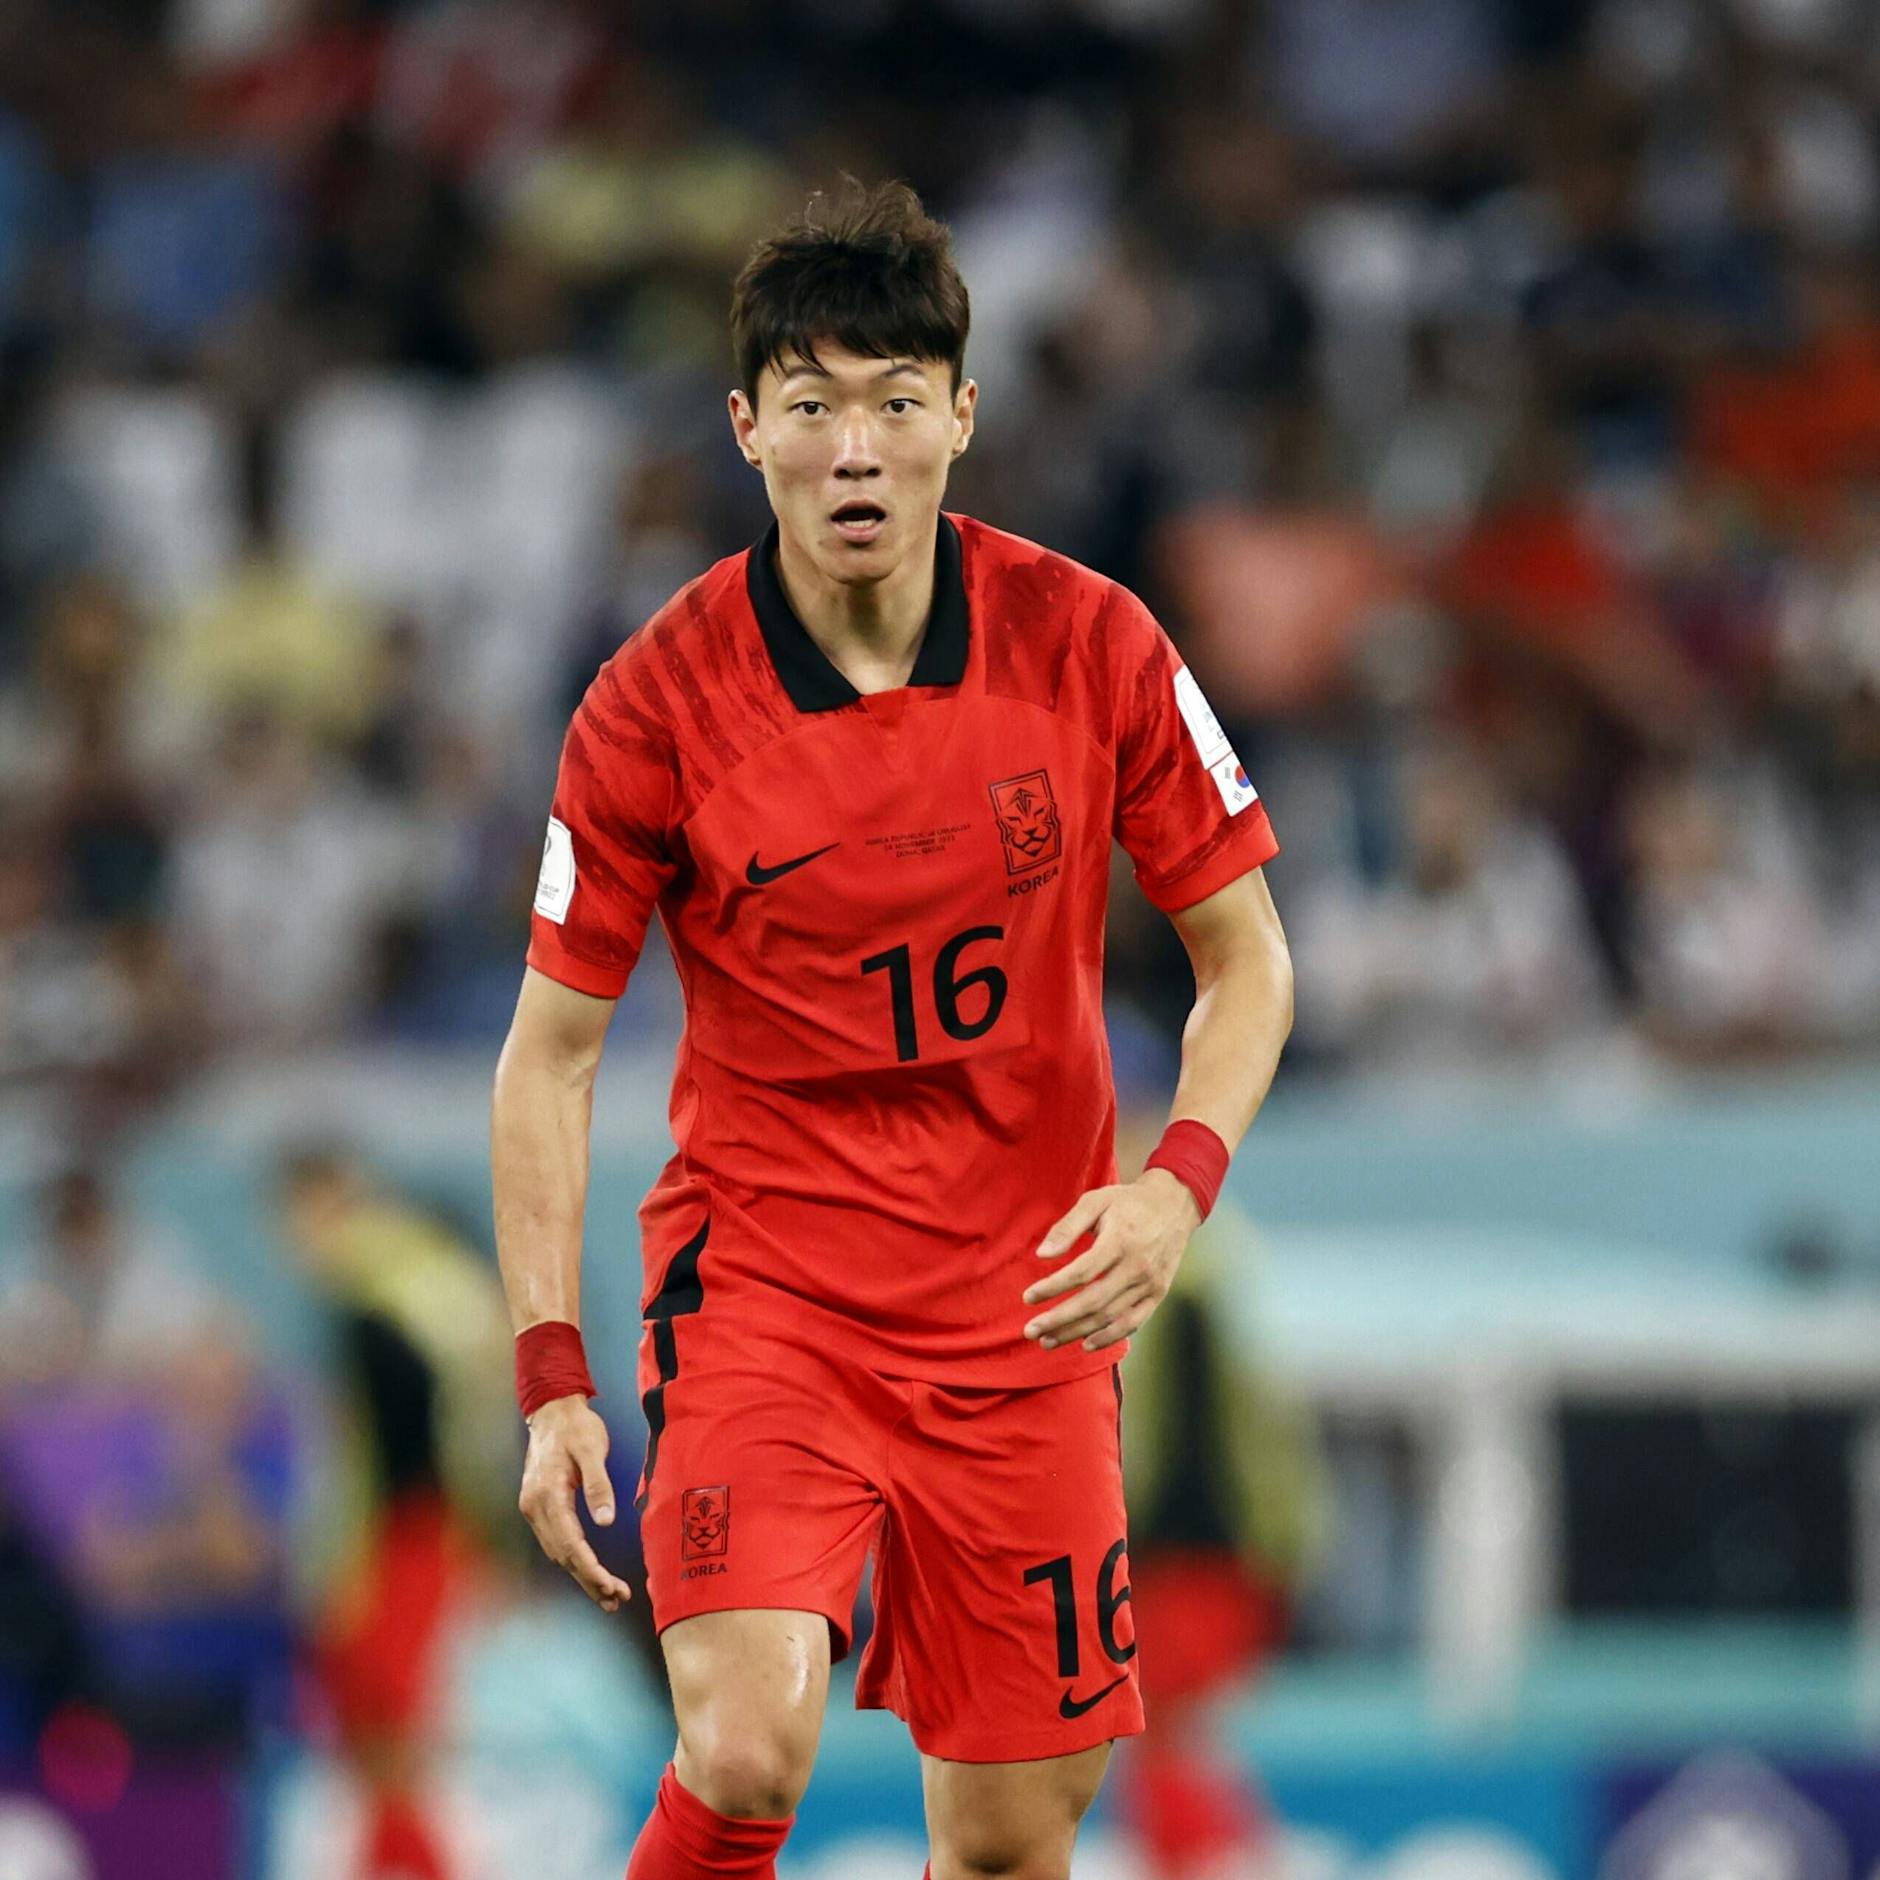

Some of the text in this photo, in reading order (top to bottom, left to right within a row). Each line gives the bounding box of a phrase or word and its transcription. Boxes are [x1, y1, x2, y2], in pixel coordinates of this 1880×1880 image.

[1008, 865, 1059, 898] KOREA
[860, 925, 1008, 1063] 16
[1023, 1538, 1136, 1678] 16
